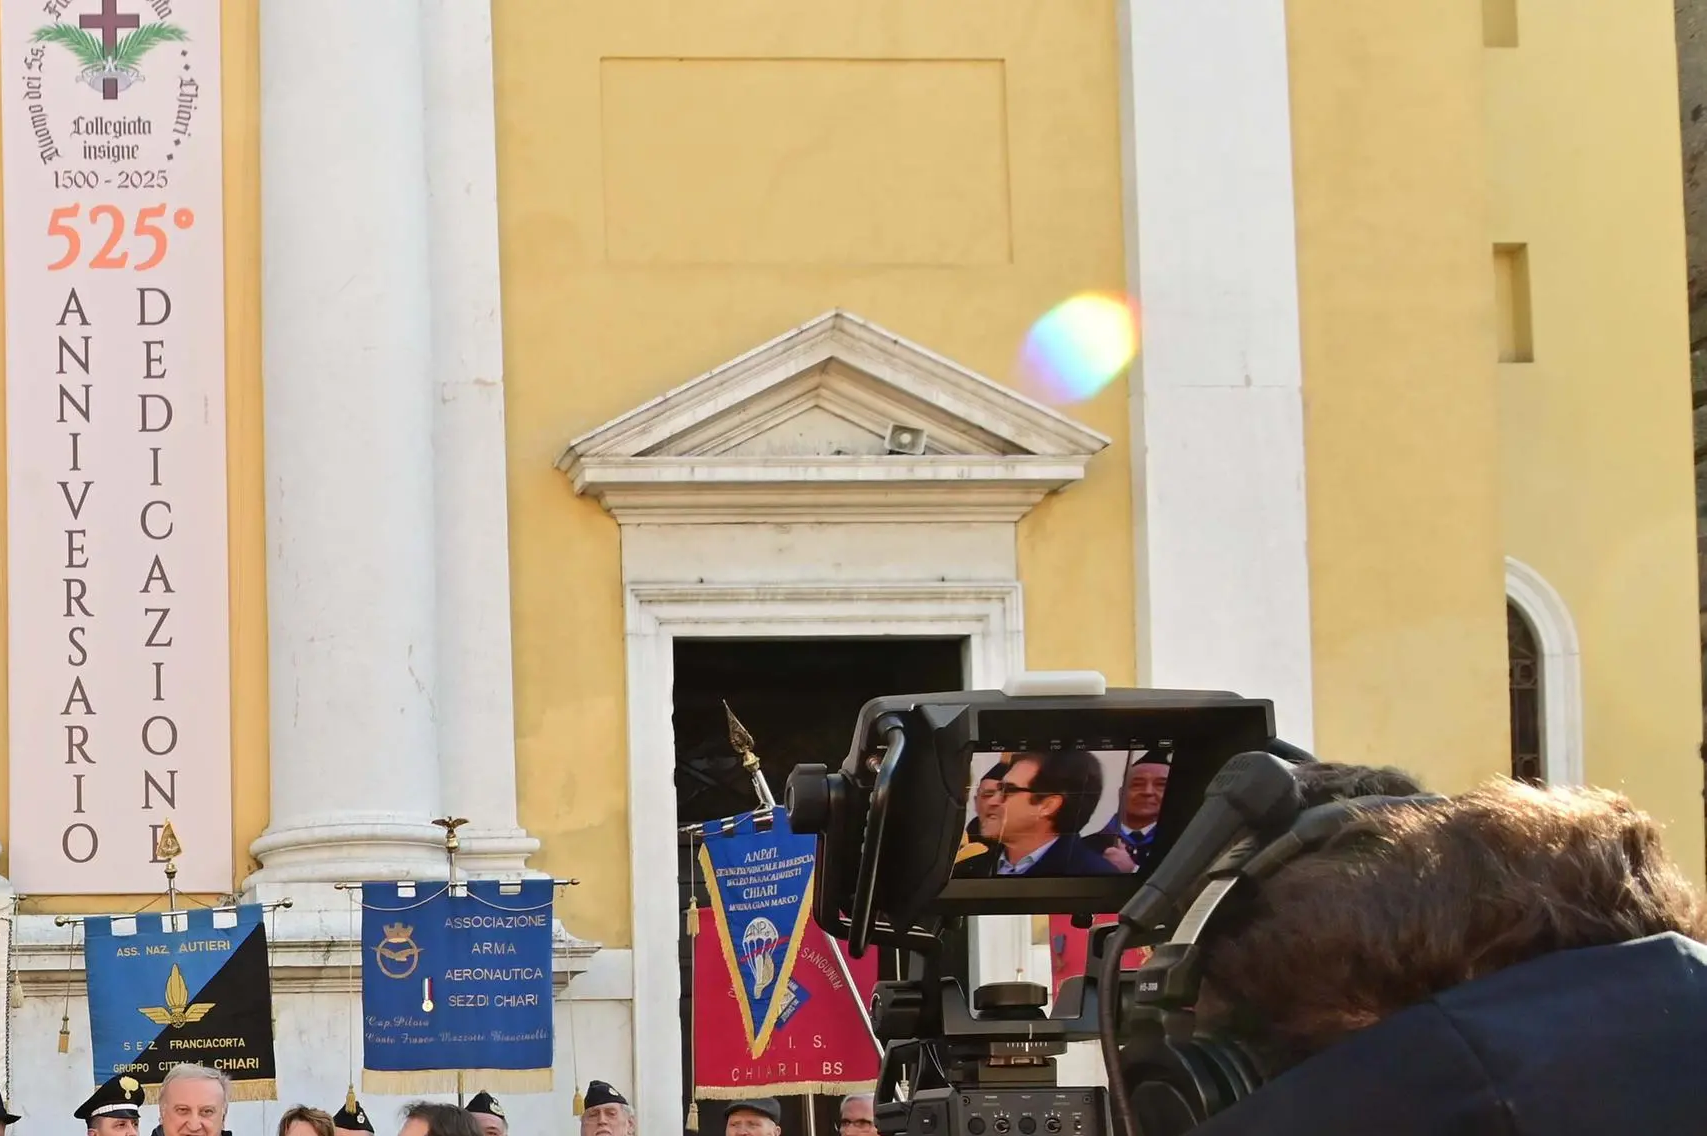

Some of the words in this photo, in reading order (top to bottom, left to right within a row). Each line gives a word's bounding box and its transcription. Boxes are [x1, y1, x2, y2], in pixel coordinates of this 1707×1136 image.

[22, 76, 42, 101] dei
[173, 76, 199, 138] Chiari
[70, 116, 152, 138] Collegiata
[83, 140, 140, 163] insigne
[54, 170, 99, 189] 1500
[117, 170, 168, 189] 2025
[55, 287, 99, 863] ANNIVERSARIO
[743, 884, 778, 900] CHIARI
[770, 894, 799, 907] MARCO
[444, 914, 547, 929] ASSOCIAZIONE
[116, 947, 141, 958] ASS.
[146, 945, 170, 956] NAZ.
[178, 940, 232, 954] AUTIERI
[471, 942, 517, 955] ARMA
[444, 967, 544, 982] AERONAUTICA
[800, 946, 843, 991] SANGUINEM
[494, 993, 539, 1007] CHIARI
[169, 1037, 246, 1050] FRANCIACORTA
[113, 1062, 150, 1074] GRUPPO
[213, 1057, 260, 1070] CHIARI
[731, 1062, 799, 1082] CHIARI
[822, 1061, 843, 1076] BS
